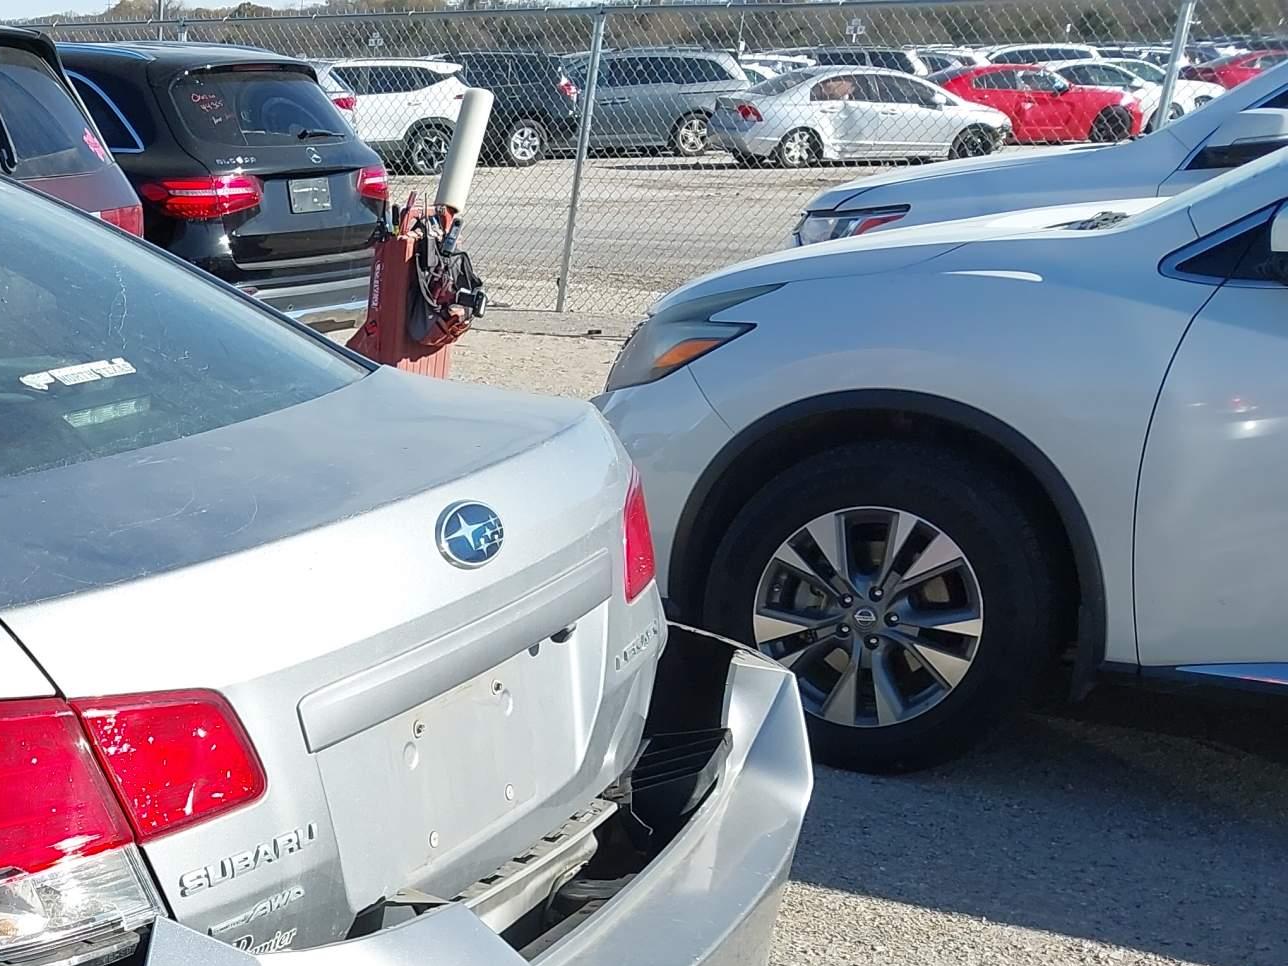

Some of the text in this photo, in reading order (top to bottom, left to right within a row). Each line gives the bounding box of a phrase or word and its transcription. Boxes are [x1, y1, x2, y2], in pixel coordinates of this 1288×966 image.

[179, 823, 318, 897] SUBARU
[247, 886, 305, 923] AWD
[232, 927, 297, 953] Pmier
